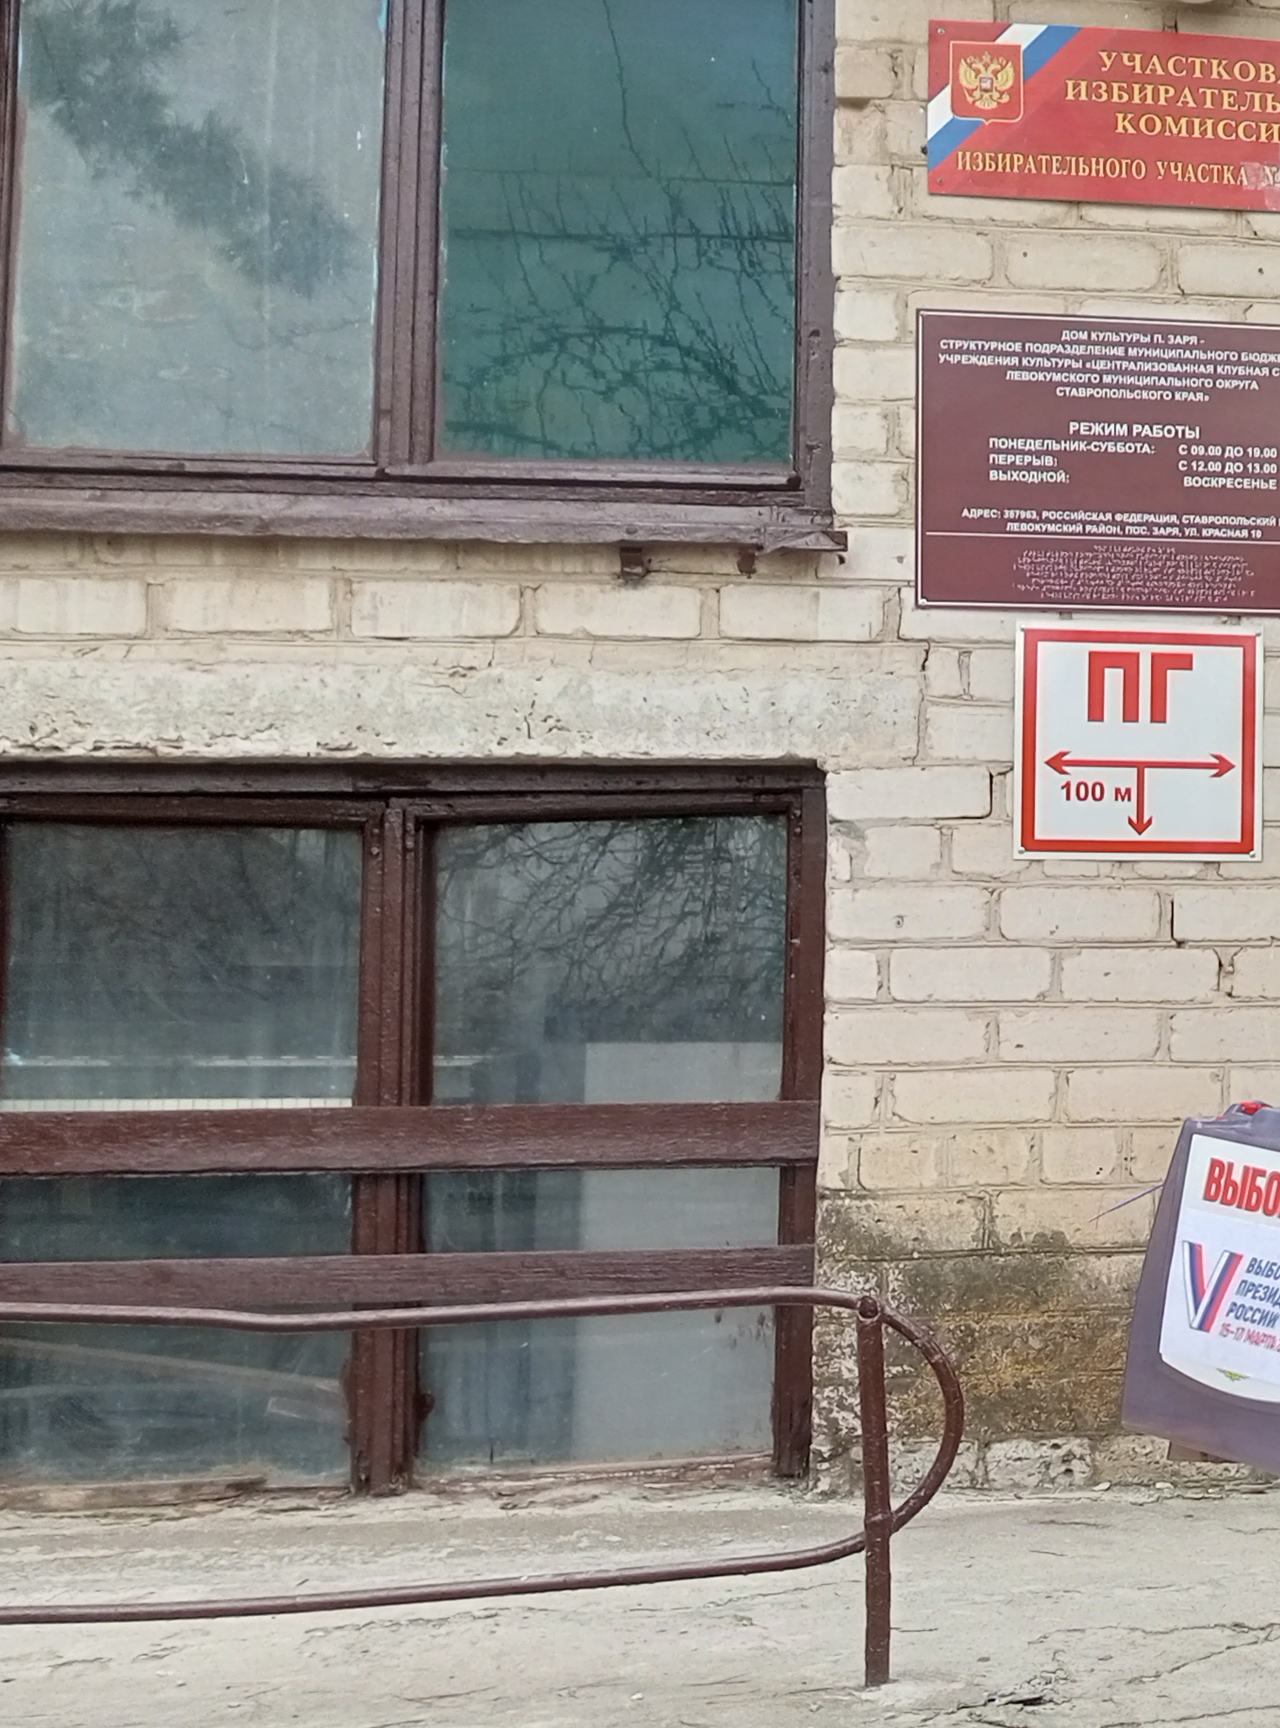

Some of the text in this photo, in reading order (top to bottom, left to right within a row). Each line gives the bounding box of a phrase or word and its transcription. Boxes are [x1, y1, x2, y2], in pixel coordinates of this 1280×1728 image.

[957, 151, 1147, 180] ИЗБИРАТЕЛЬНОГО
[1156, 161, 1249, 186] УЧАСТКА
[1061, 330, 1088, 341] ДОМ
[1090, 331, 1150, 343] КУЛЬТУРЫ
[1168, 335, 1197, 345] ЗАРЯ
[940, 339, 1022, 352] СТРУКТУРНОЕ
[1025, 342, 1125, 356] ПОДРАЗДЕЛЕНИЕ
[1128, 347, 1238, 361] МУНИЦИПАЛЬНОГО
[938, 353, 1019, 367] УЧРЕЖДЕНИЯ
[1022, 357, 1082, 369] КУЛЬТУРЫ
[1217, 365, 1269, 376] КЛУБНАЯ
[1006, 370, 1259, 390] ЛЕВОКУМСКОГО МУНИЦИПАЛЬНОГО ОКРУГА
[1056, 387, 1172, 400] СТАВРОПОЛЬСКОГО
[1069, 422, 1200, 439] РЕЖИМ РАБОТЫ
[989, 437, 1278, 458] ПОНЕДЕЛЬНИК-СУББОТА: С 09.00 ДО 19.00
[1178, 460, 1188, 471] С
[1190, 460, 1222, 472] 12.00
[1224, 461, 1244, 474] ДО
[1247, 462, 1278, 474] 13.00
[989, 469, 1278, 490] ВЫХОДНОЙ: ВОСКРЕСЕНЬЕ
[961, 507, 1001, 519] АДРЕС:
[1042, 510, 1112, 521] РОССИЙСКАЯ
[1182, 514, 1276, 526] СТАВРОПОЛЬСКИЙ
[1006, 522, 1083, 534] ЛЕВОКУМСКИЙ
[1202, 528, 1248, 538] КРАСНАЯ
[1088, 651, 1193, 724] ПГ
[1061, 781, 1105, 802] 100
[1225, 1301, 1280, 1328] РОССИИ
[1243, 1328, 1277, 1350] МАРТА
